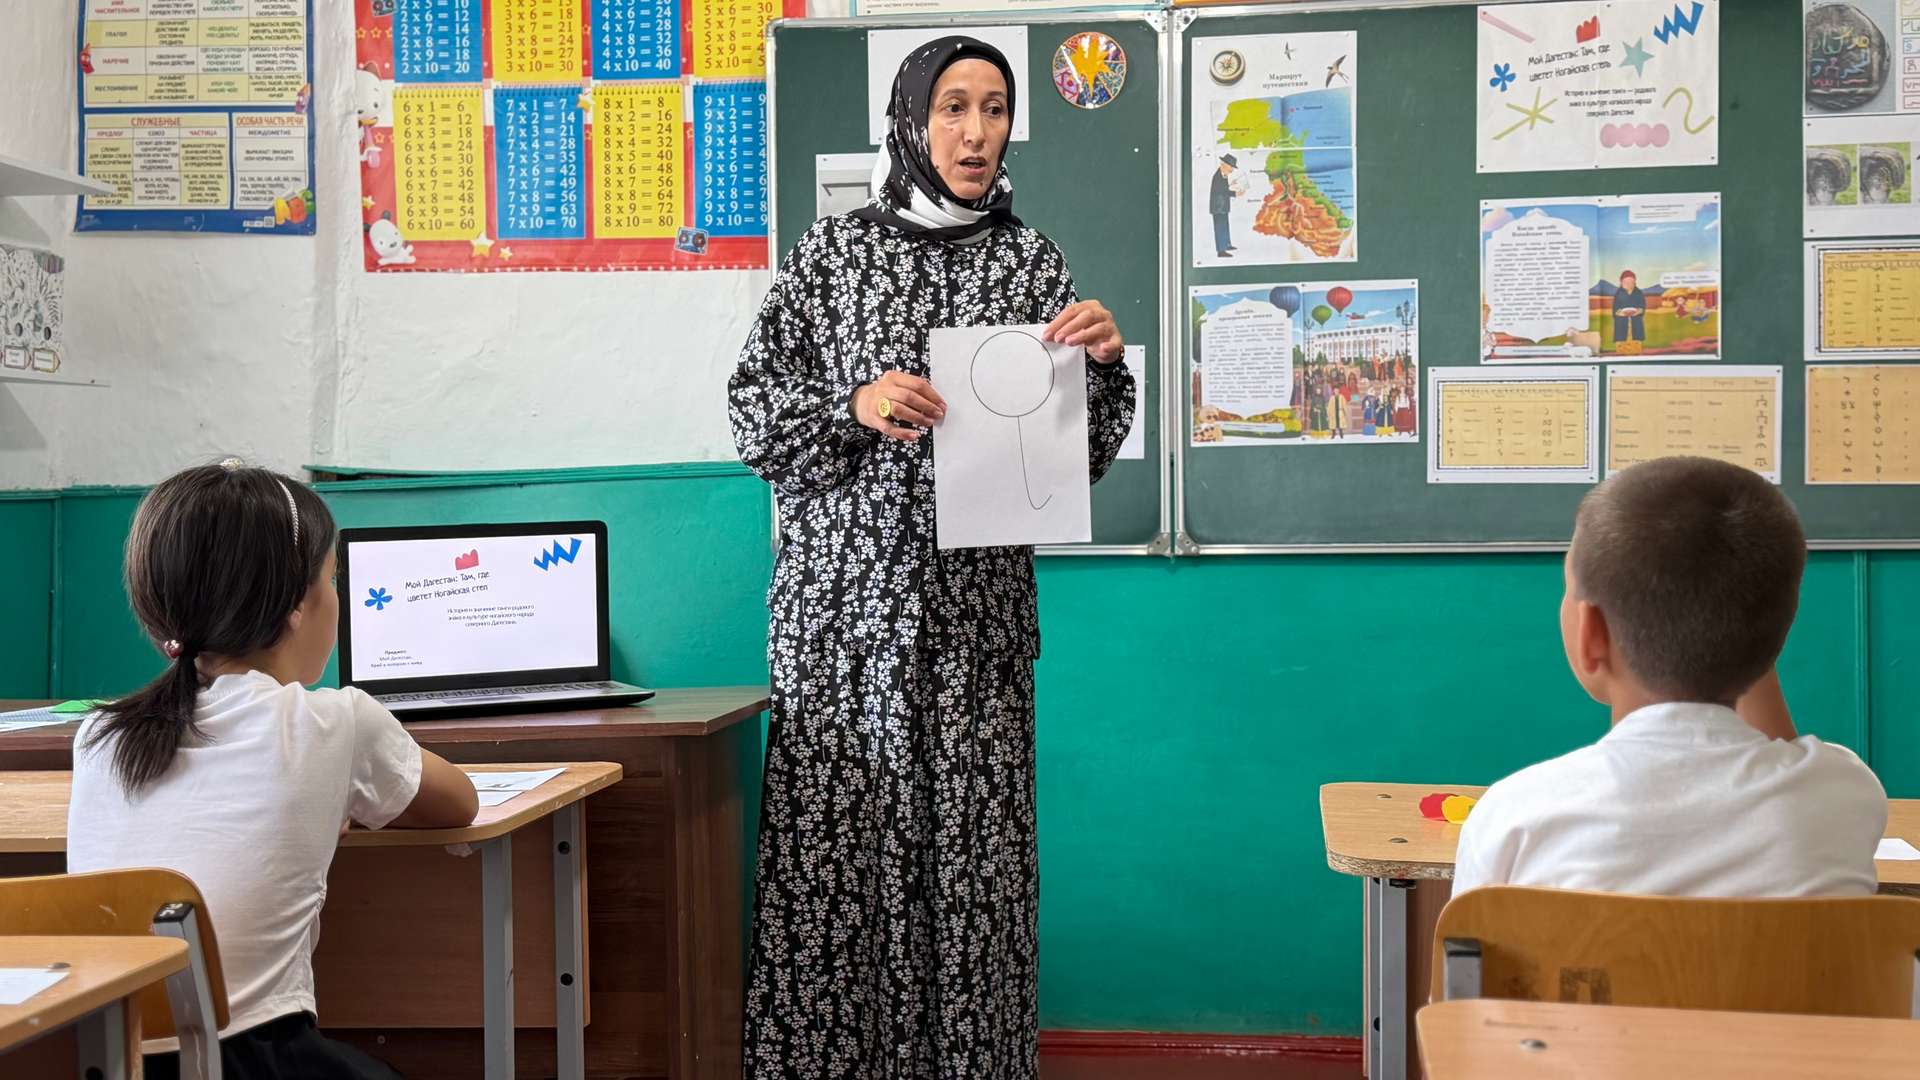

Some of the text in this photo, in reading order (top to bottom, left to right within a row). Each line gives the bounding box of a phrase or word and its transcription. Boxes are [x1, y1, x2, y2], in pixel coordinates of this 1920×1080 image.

[506, 9, 512, 20] 3
[530, 9, 537, 20] 6
[560, 8, 573, 19] 18
[602, 8, 610, 19] 4
[627, 7, 635, 19] 6
[656, 6, 671, 18] 24
[704, 5, 711, 16] 5
[729, 4, 736, 15] 6
[758, 2, 773, 13] 30
[401, 10, 408, 23] 2
[425, 10, 433, 23] 6
[455, 9, 469, 22] 12
[402, 36, 408, 49] 2
[426, 36, 433, 49] 8
[456, 36, 469, 47] 16
[1528, 56, 1543, 66] Мой
[1598, 44, 1610, 52] где
[402, 62, 409, 74] 2
[426, 62, 438, 73] 10
[456, 61, 469, 73] 20
[507, 61, 513, 72] 3
[530, 61, 542, 72] 10
[560, 60, 573, 72] 30
[603, 60, 610, 71] 4
[626, 60, 639, 71] 10
[656, 59, 671, 70] 40
[1555, 65, 1589, 77] Ногайская
[403, 101, 411, 112] 6
[430, 101, 434, 112] 1
[457, 101, 464, 112] 6
[507, 99, 514, 110] 7
[534, 99, 537, 111] 1
[560, 98, 566, 110] 7
[604, 98, 610, 109] 8
[630, 98, 633, 108] 1
[657, 96, 664, 108] 8
[705, 96, 712, 108] 9
[731, 95, 734, 106] 1
[759, 94, 767, 107] 9
[131, 117, 180, 126] СЛУЖЕБНЫЕ
[237, 117, 304, 126] ОСОБАЯ ЧАСТЬ РЕЧИ
[405, 154, 412, 165] 6
[430, 154, 436, 165] 5
[459, 153, 473, 164] 30
[508, 152, 514, 163] 7
[533, 152, 539, 163] 5
[560, 151, 575, 163] 35
[604, 151, 611, 161] 8
[629, 150, 635, 161] 5
[657, 149, 673, 160] 40
[407, 219, 414, 230] 6
[429, 219, 442, 230] 10
[460, 218, 475, 229] 60
[509, 217, 515, 228] 7
[530, 217, 543, 228] 10
[562, 216, 576, 228] 70
[604, 216, 611, 227] 8
[627, 216, 639, 227] 10
[659, 215, 673, 226] 80
[405, 581, 421, 589] Мой
[423, 576, 458, 587] Дагестан:
[408, 592, 432, 602] цветет
[434, 587, 470, 598] Ногайская
